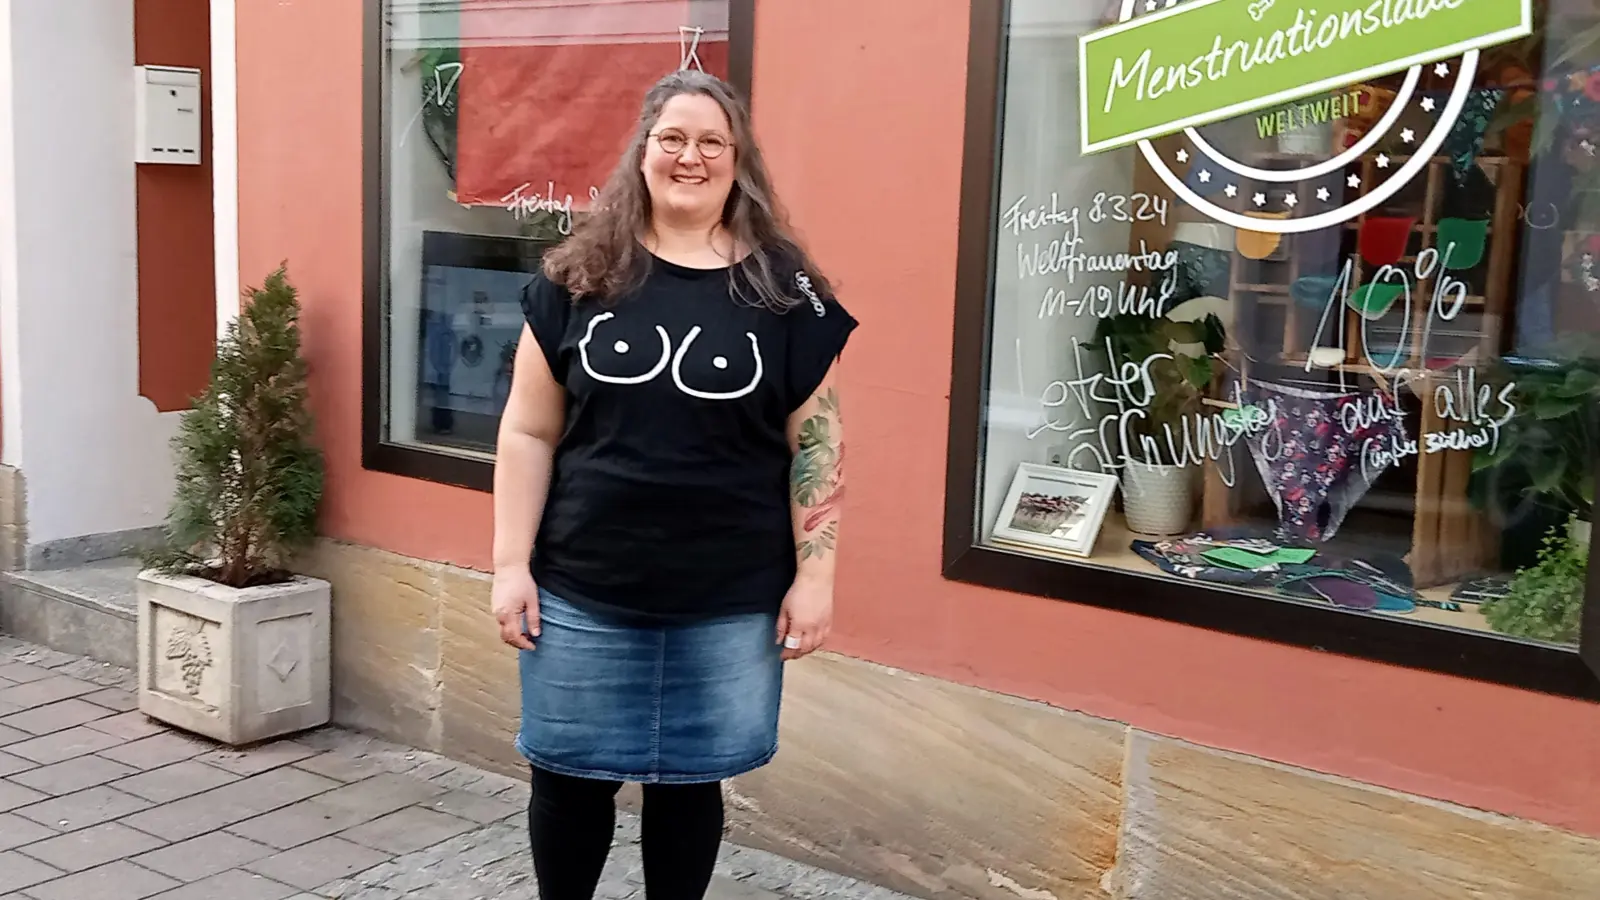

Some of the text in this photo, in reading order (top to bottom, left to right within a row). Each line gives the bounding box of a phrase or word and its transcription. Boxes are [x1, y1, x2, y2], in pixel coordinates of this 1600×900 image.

[1103, 0, 1464, 113] Menstruationsla
[1255, 90, 1364, 139] WELTWEIT
[500, 181, 573, 235] Freitag
[1003, 192, 1168, 238] Freitag 8.3.24
[1016, 230, 1180, 297] Weltfrauentag
[1116, 281, 1173, 318] Uhr
[1304, 240, 1468, 393] 10%
[1434, 367, 1517, 428] alles
